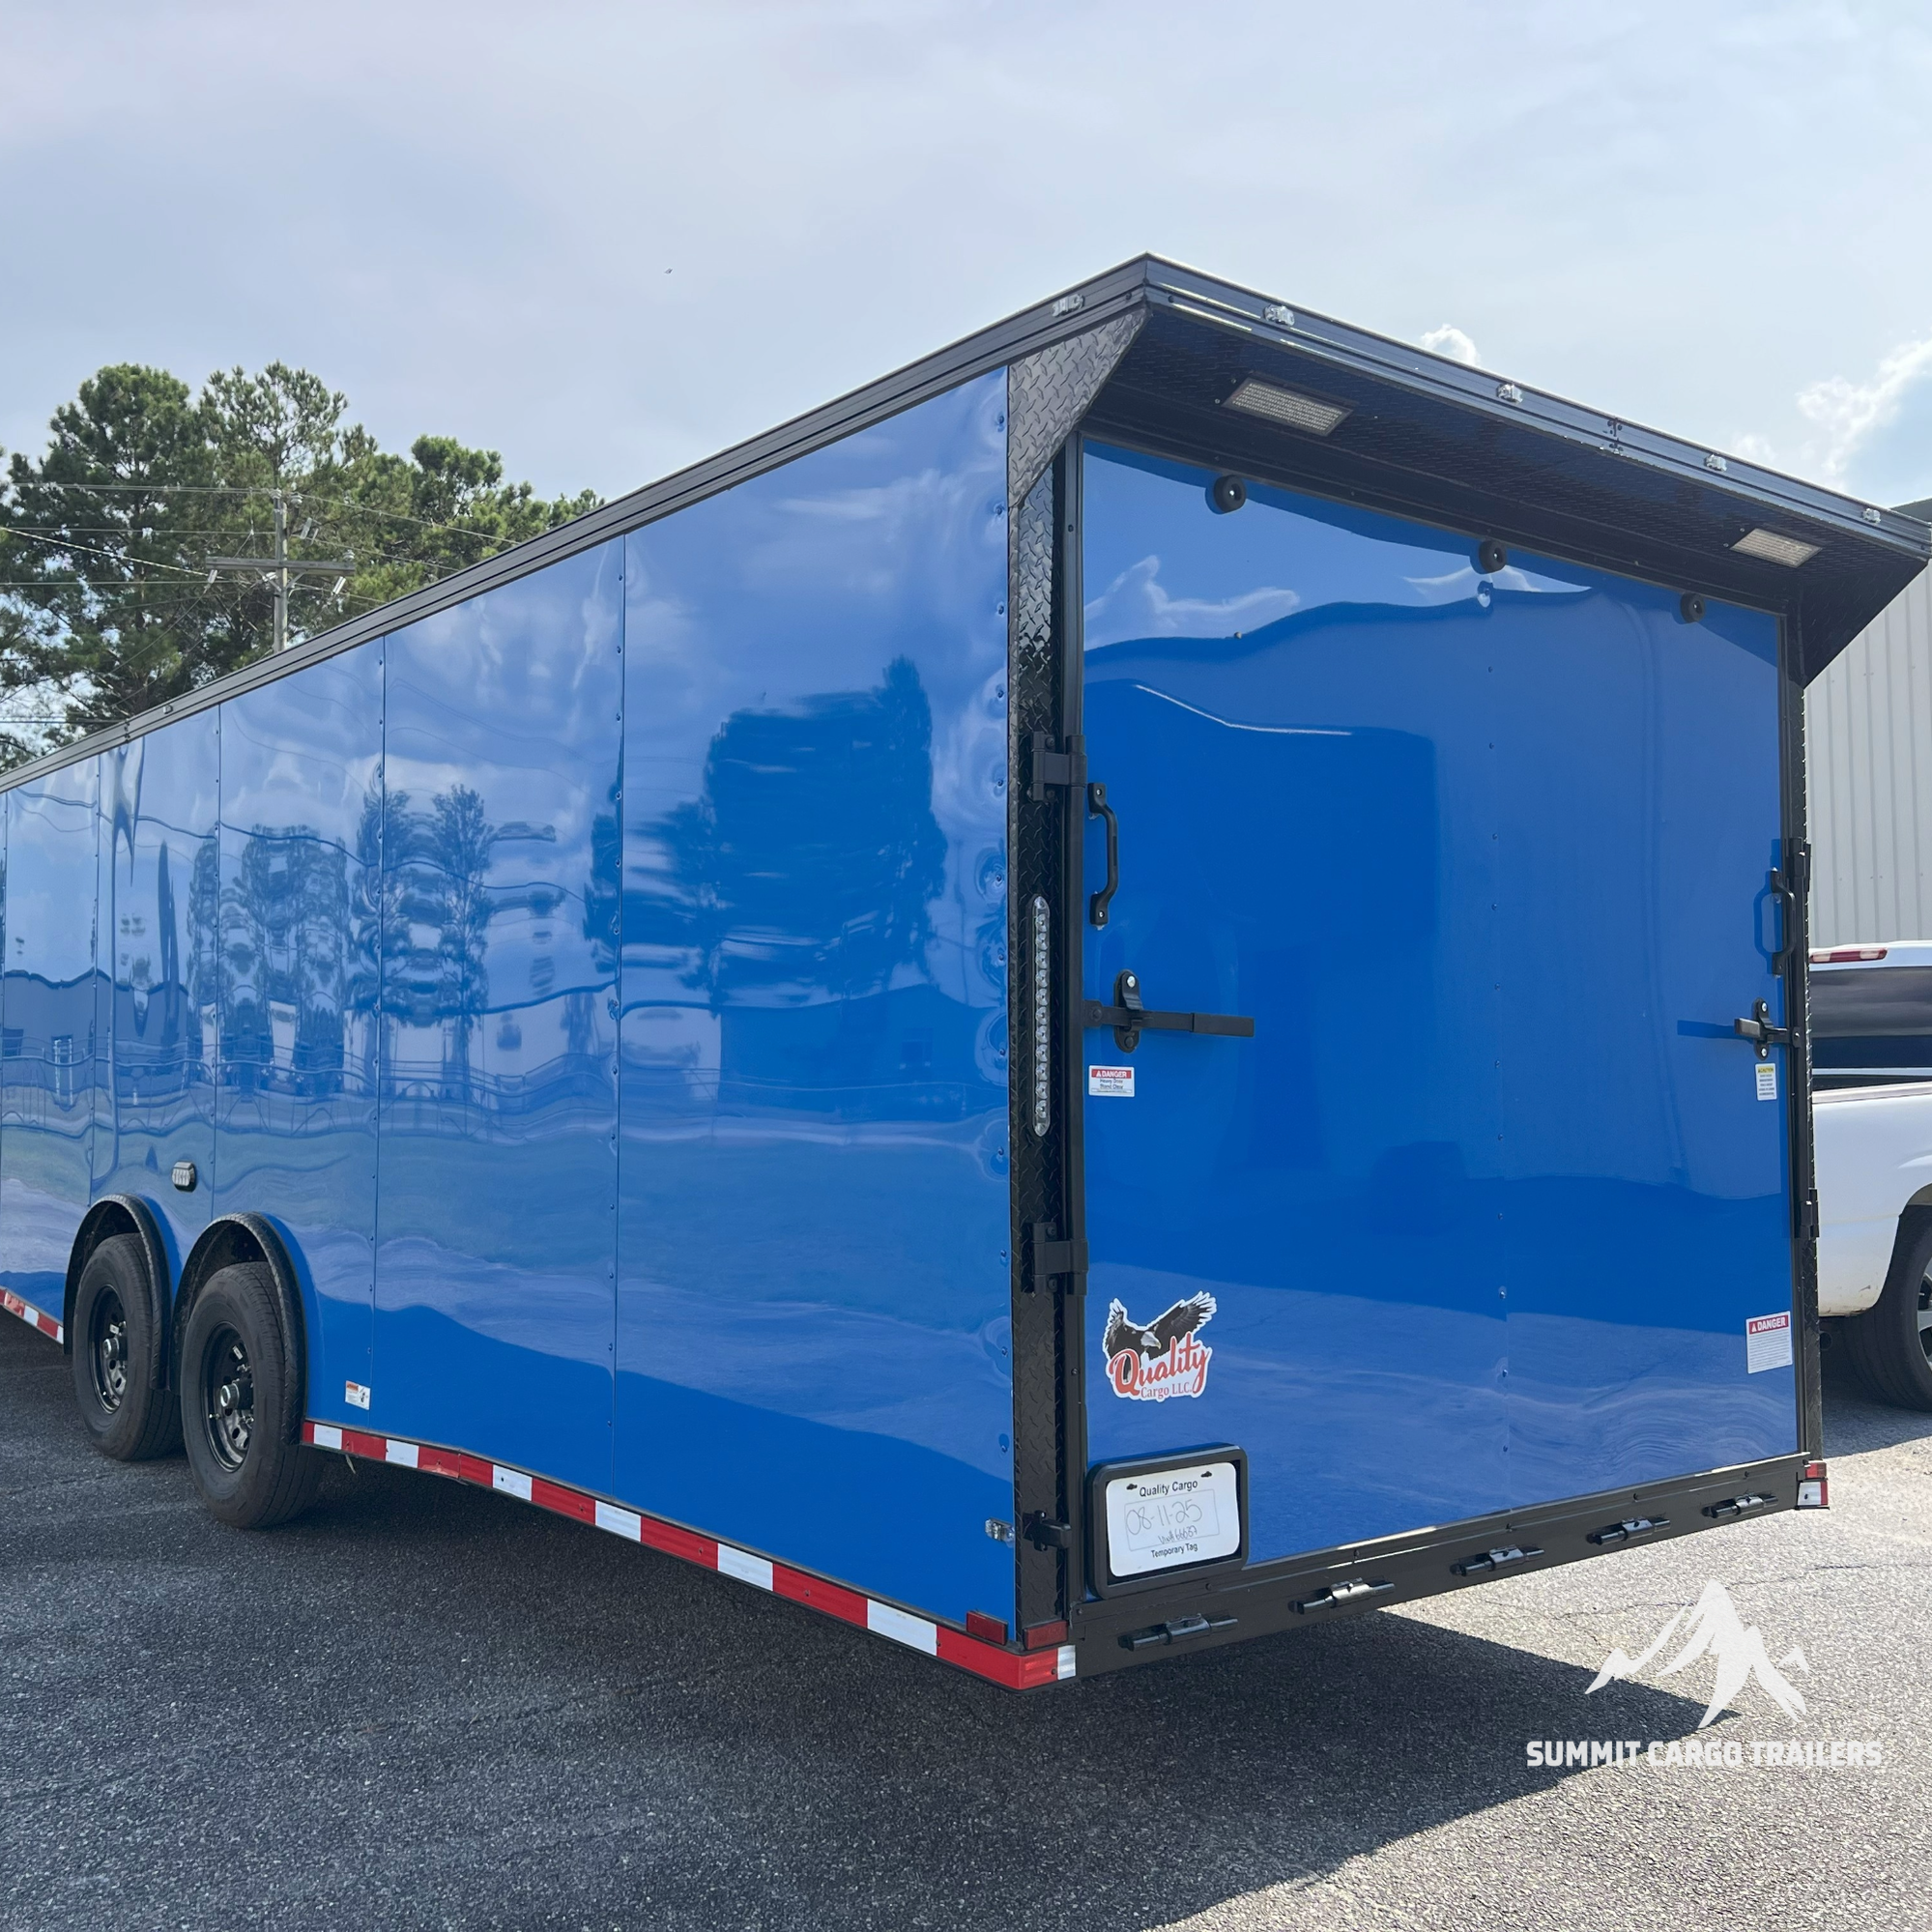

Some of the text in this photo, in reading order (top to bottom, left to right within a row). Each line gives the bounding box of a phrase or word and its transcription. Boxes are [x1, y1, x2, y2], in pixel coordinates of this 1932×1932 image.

[1102, 1070, 1127, 1079] DANGER
[1757, 1316, 1786, 1331] DANGER
[1109, 1333, 1210, 1396] Quality
[1140, 1386, 1169, 1399] Cargo
[1139, 1480, 1198, 1497] Quality Cargo
[1126, 1499, 1202, 1535] 08-11-25
[1151, 1543, 1198, 1558] Temporary Tag
